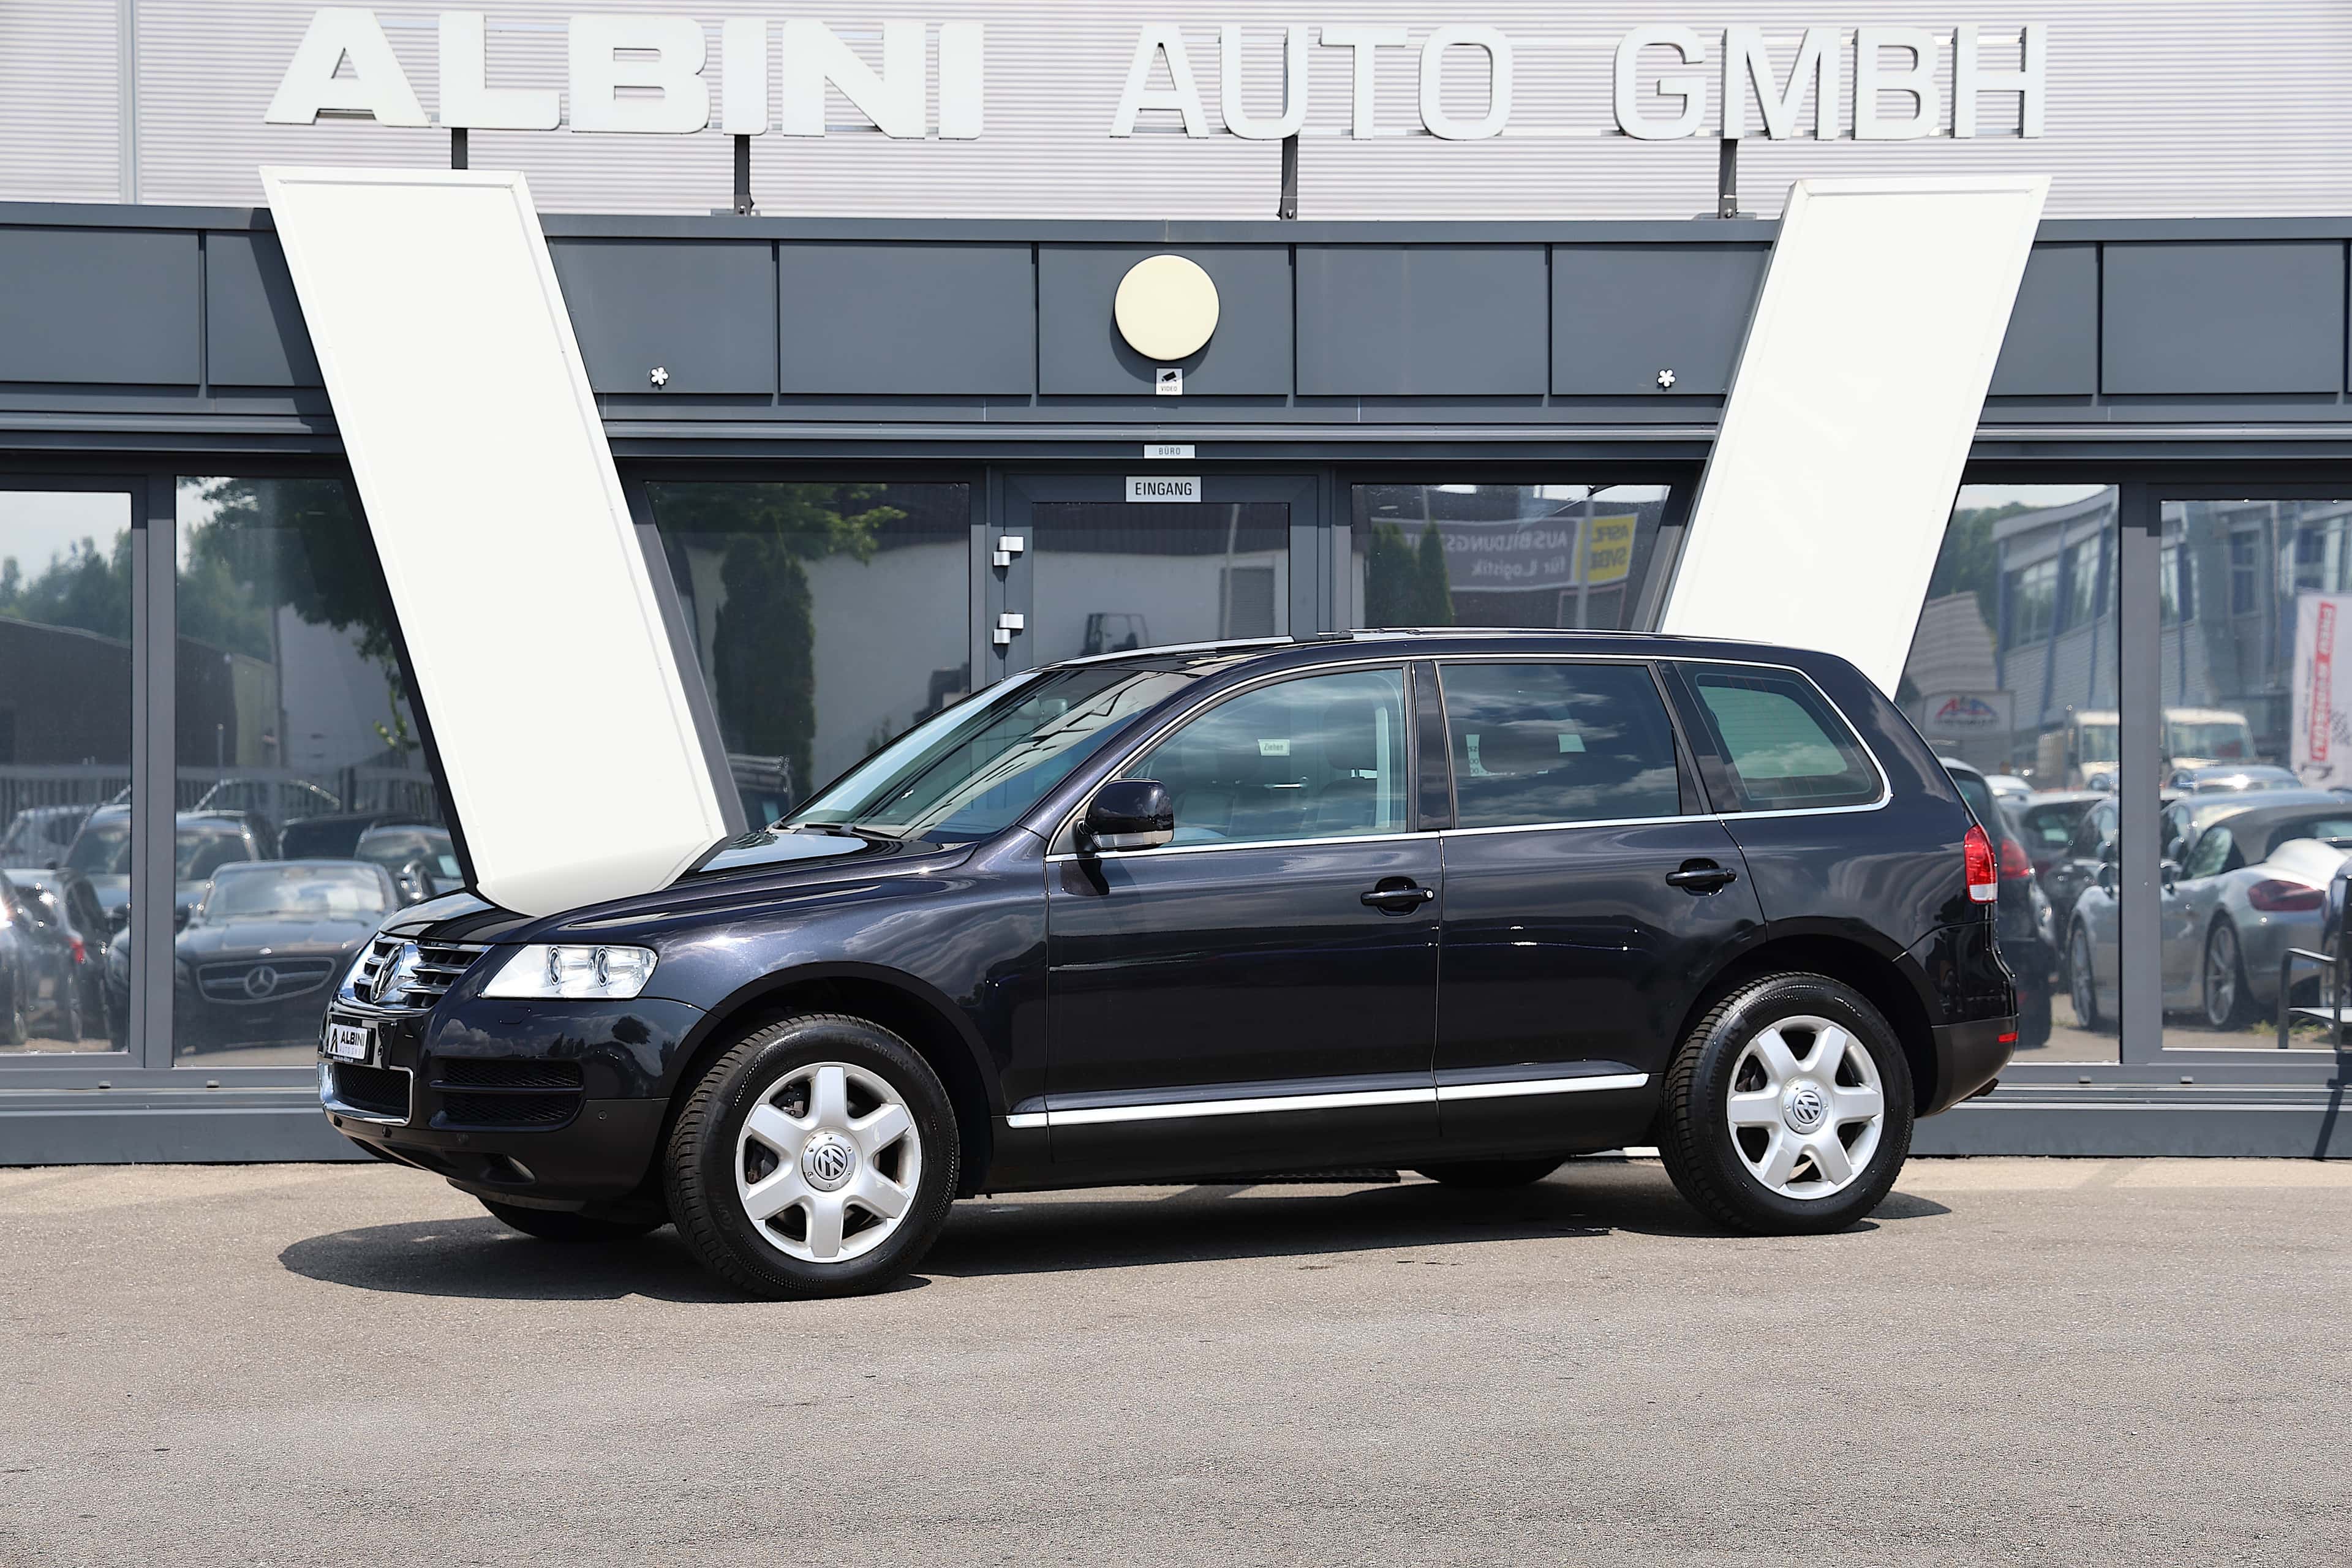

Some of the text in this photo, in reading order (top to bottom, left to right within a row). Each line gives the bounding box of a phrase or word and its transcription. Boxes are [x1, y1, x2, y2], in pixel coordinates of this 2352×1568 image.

[263, 7, 2049, 141] ALBINI AUTO GMBH
[1158, 445, 1181, 455] BÜRO
[1135, 481, 1192, 496] EINGANG
[341, 1031, 365, 1046] ALBINI
